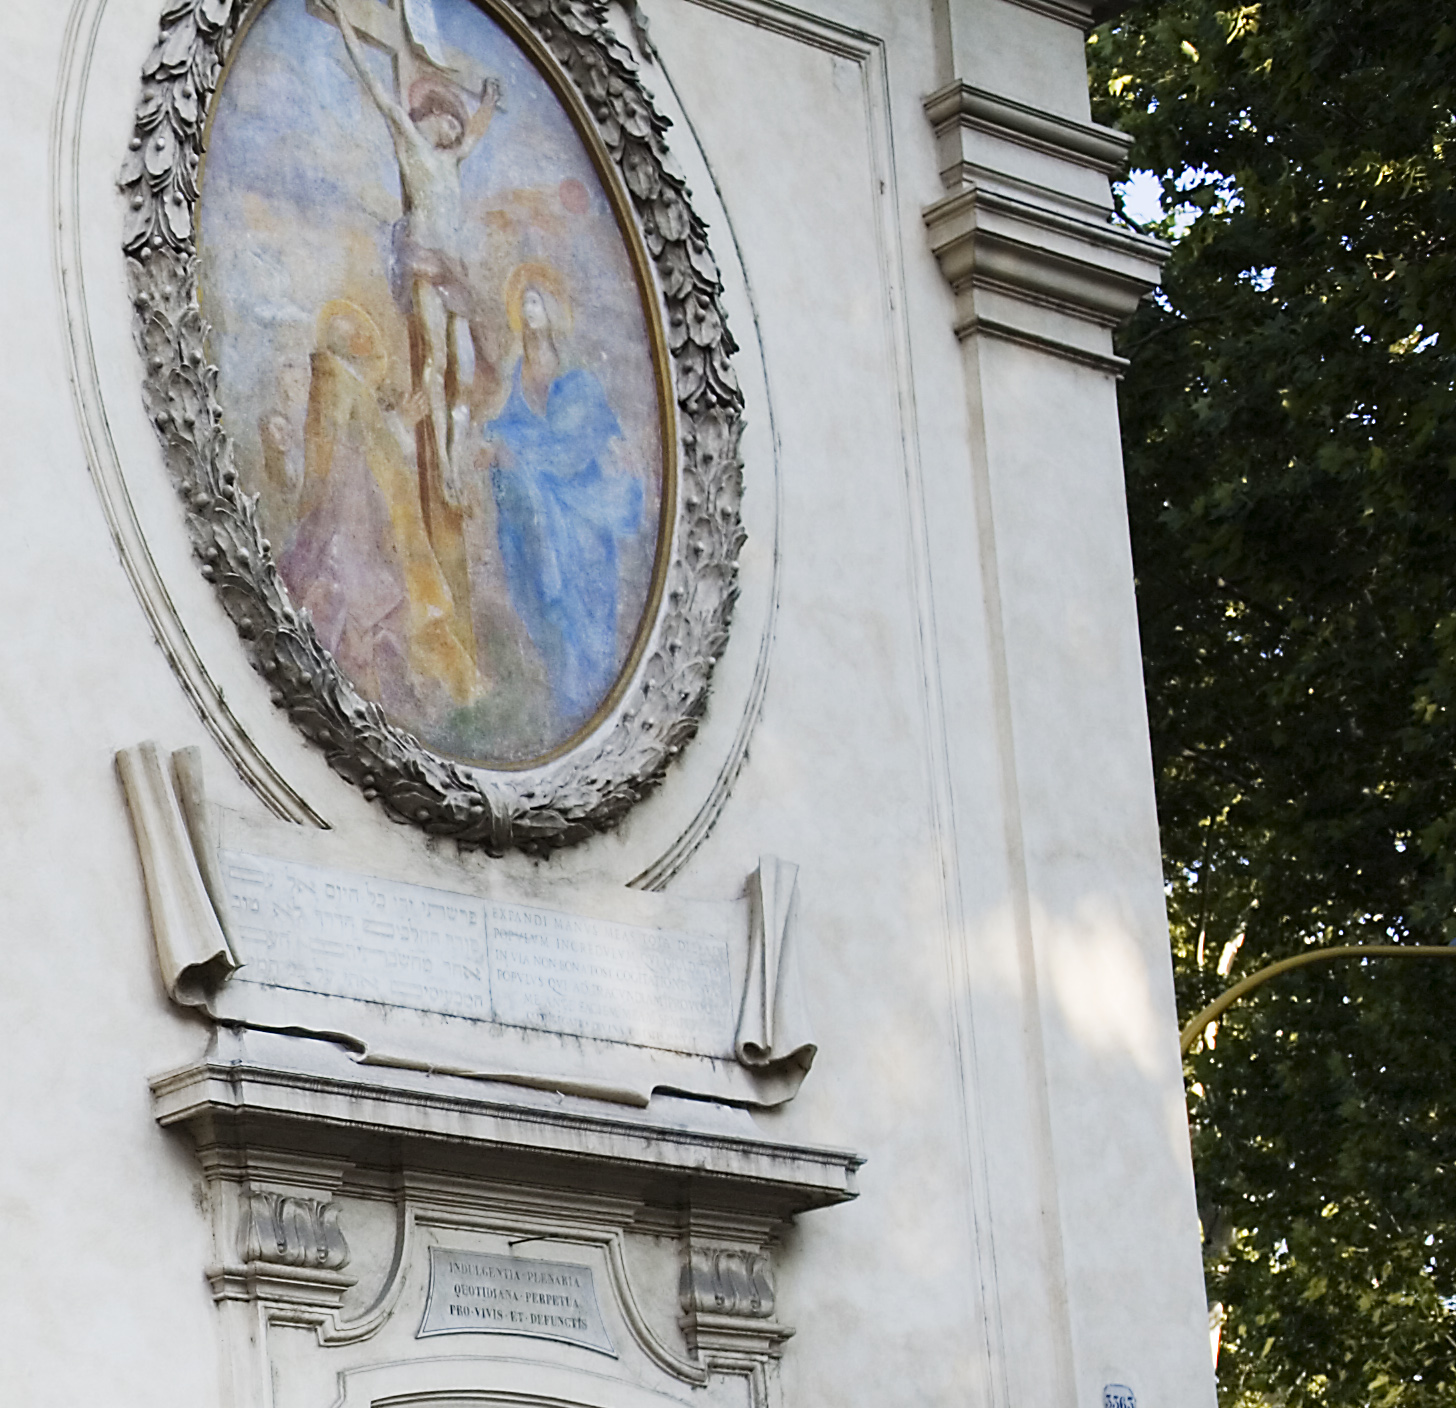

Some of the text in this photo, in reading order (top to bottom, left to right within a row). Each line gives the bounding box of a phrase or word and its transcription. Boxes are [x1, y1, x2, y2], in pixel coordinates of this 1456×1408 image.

[492, 907, 547, 927] EXPANDI
[554, 918, 599, 936] MANVS
[495, 949, 507, 960] IN
[511, 952, 529, 966] VIA
[533, 955, 556, 968] NON
[496, 968, 544, 988] POPVLVS
[449, 1261, 581, 1288] INDULGENTIA PLENARIA
[454, 1283, 579, 1309] QUOTIDIANA PERPETUA
[449, 1304, 588, 1330] PRO VIVIS ET DEFUNCTIS
